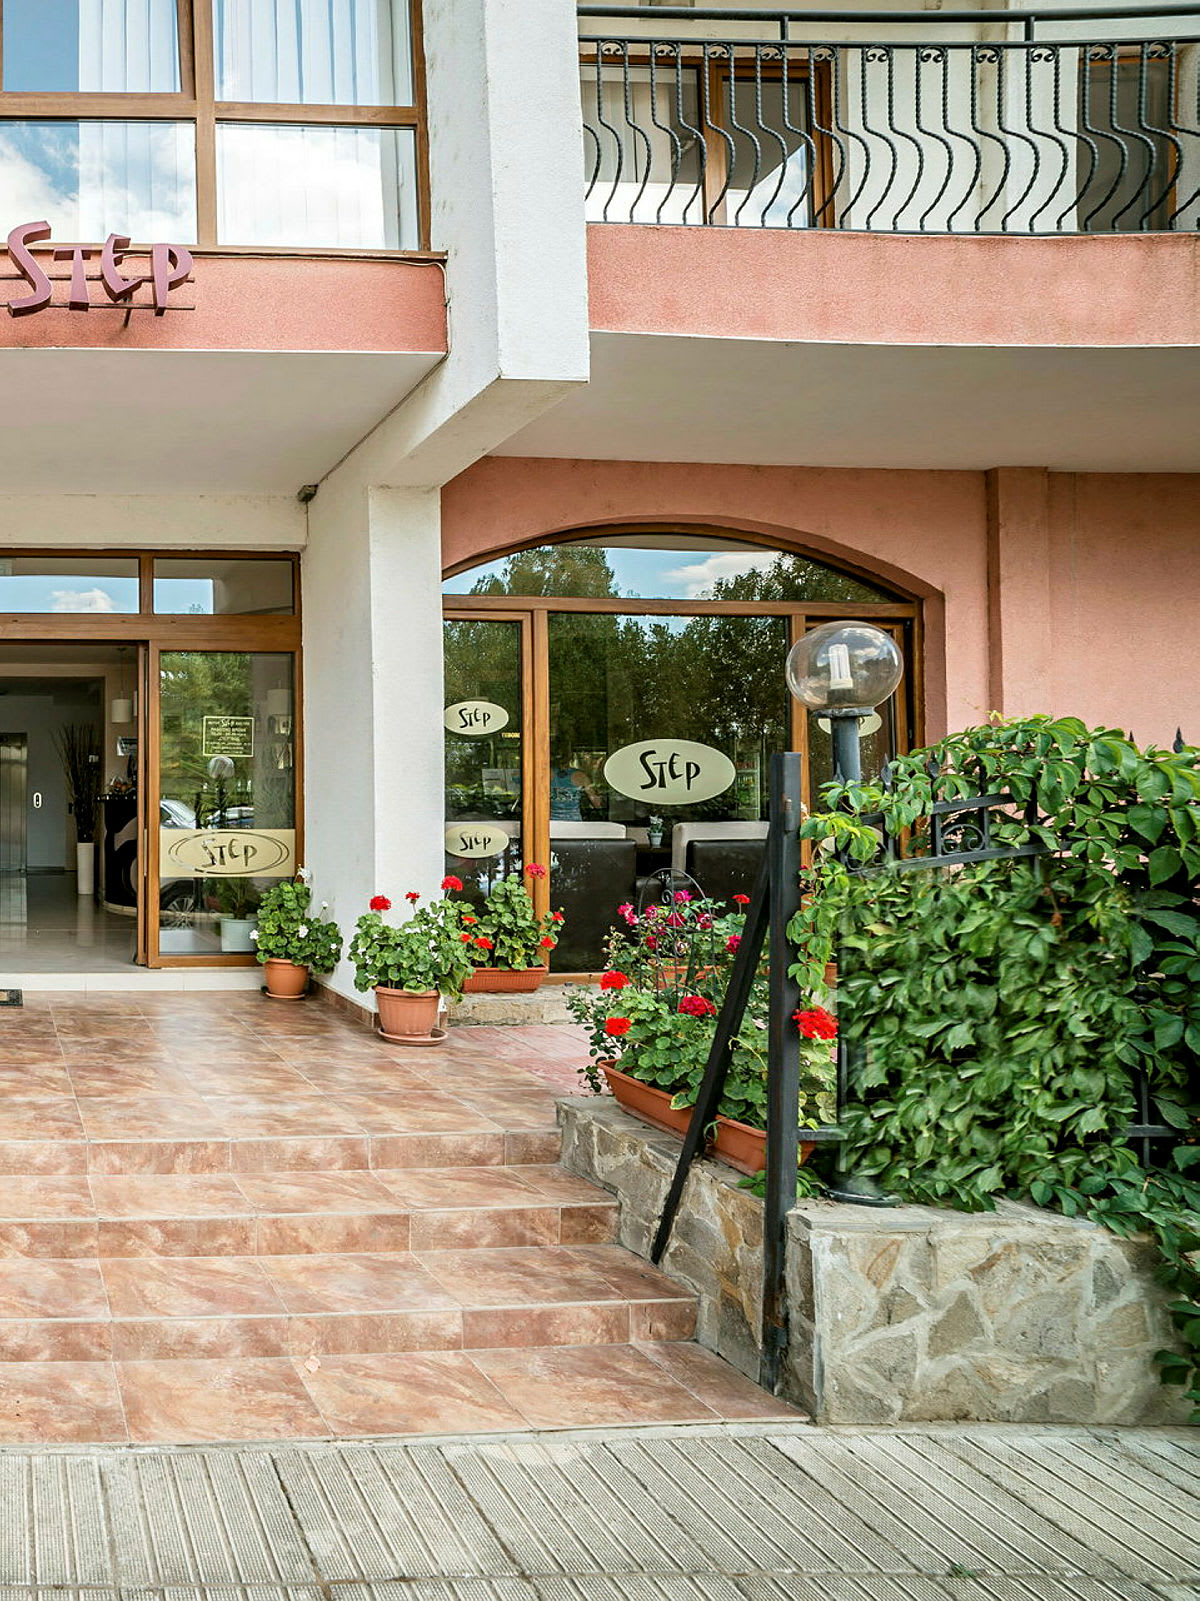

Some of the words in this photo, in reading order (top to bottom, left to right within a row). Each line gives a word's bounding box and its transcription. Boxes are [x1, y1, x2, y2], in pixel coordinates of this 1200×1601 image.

[8, 220, 193, 317] STEP
[459, 708, 491, 728] STEP
[640, 750, 700, 790] STEP
